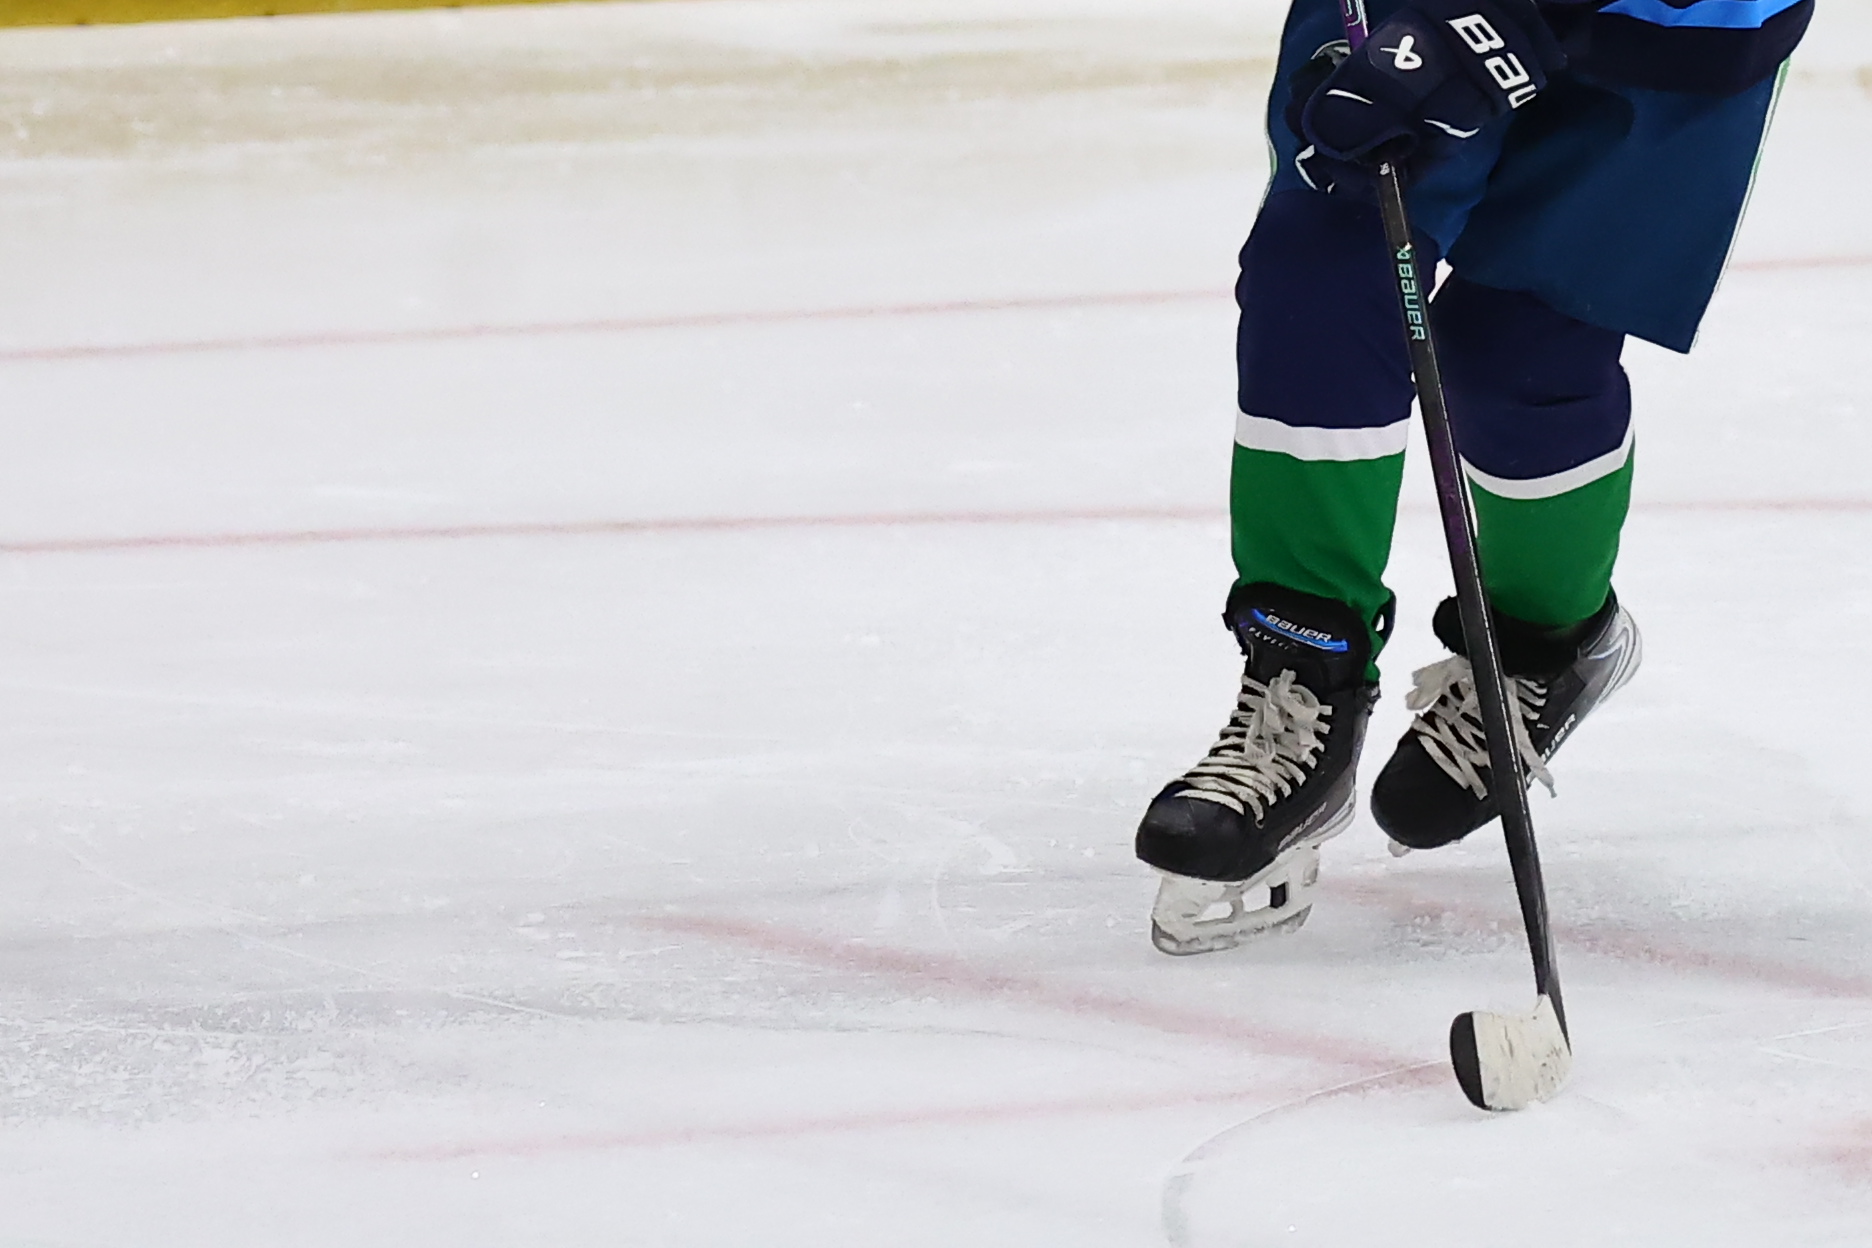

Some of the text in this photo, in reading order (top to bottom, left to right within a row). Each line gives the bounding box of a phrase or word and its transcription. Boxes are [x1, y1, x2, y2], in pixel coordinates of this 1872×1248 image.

[1445, 13, 1538, 110] BAU
[1397, 262, 1427, 342] BAUER
[1265, 614, 1332, 643] BAUER
